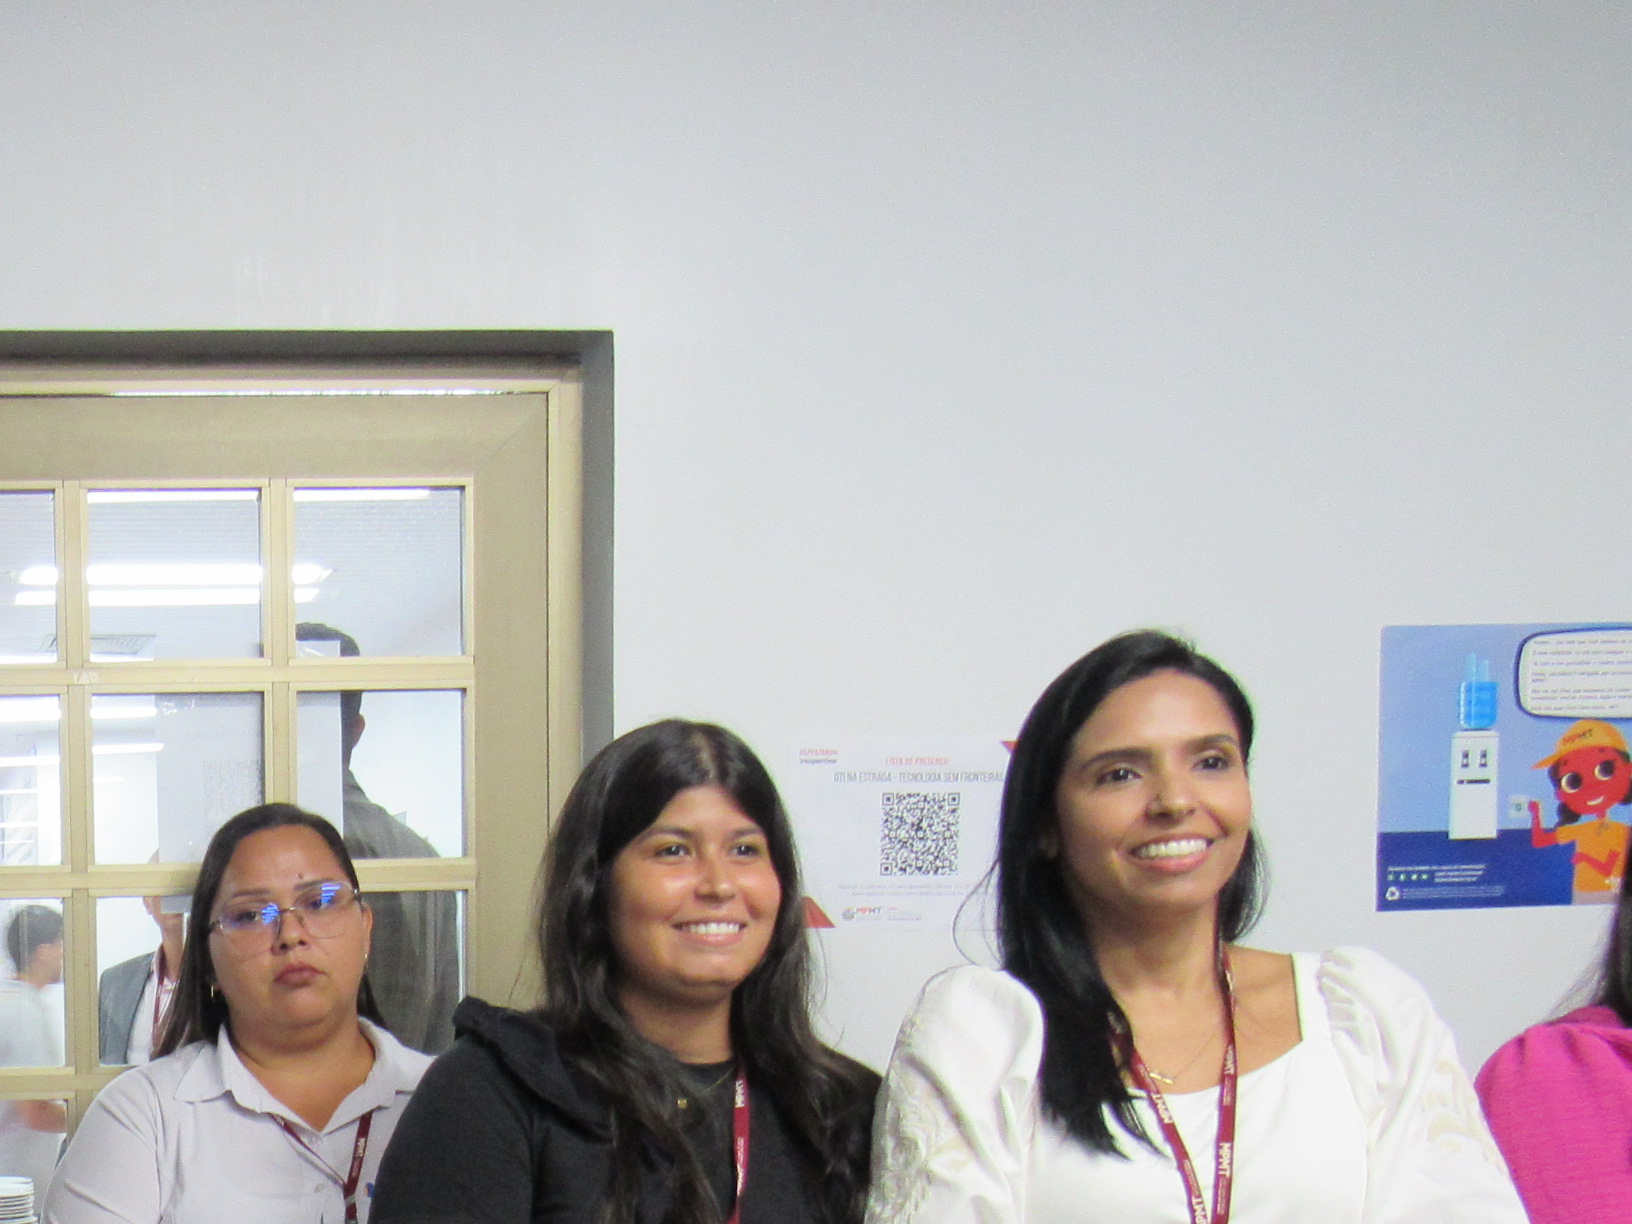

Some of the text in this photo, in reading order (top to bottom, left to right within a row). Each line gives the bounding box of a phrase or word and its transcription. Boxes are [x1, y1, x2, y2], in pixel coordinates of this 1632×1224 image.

[847, 772, 857, 782] NA
[859, 772, 892, 782] ESTRADA
[899, 772, 941, 782] TECNOLOGIA
[943, 772, 959, 782] SEM
[1152, 1092, 1172, 1124] MPMT
[1218, 1142, 1231, 1177] MPMT
